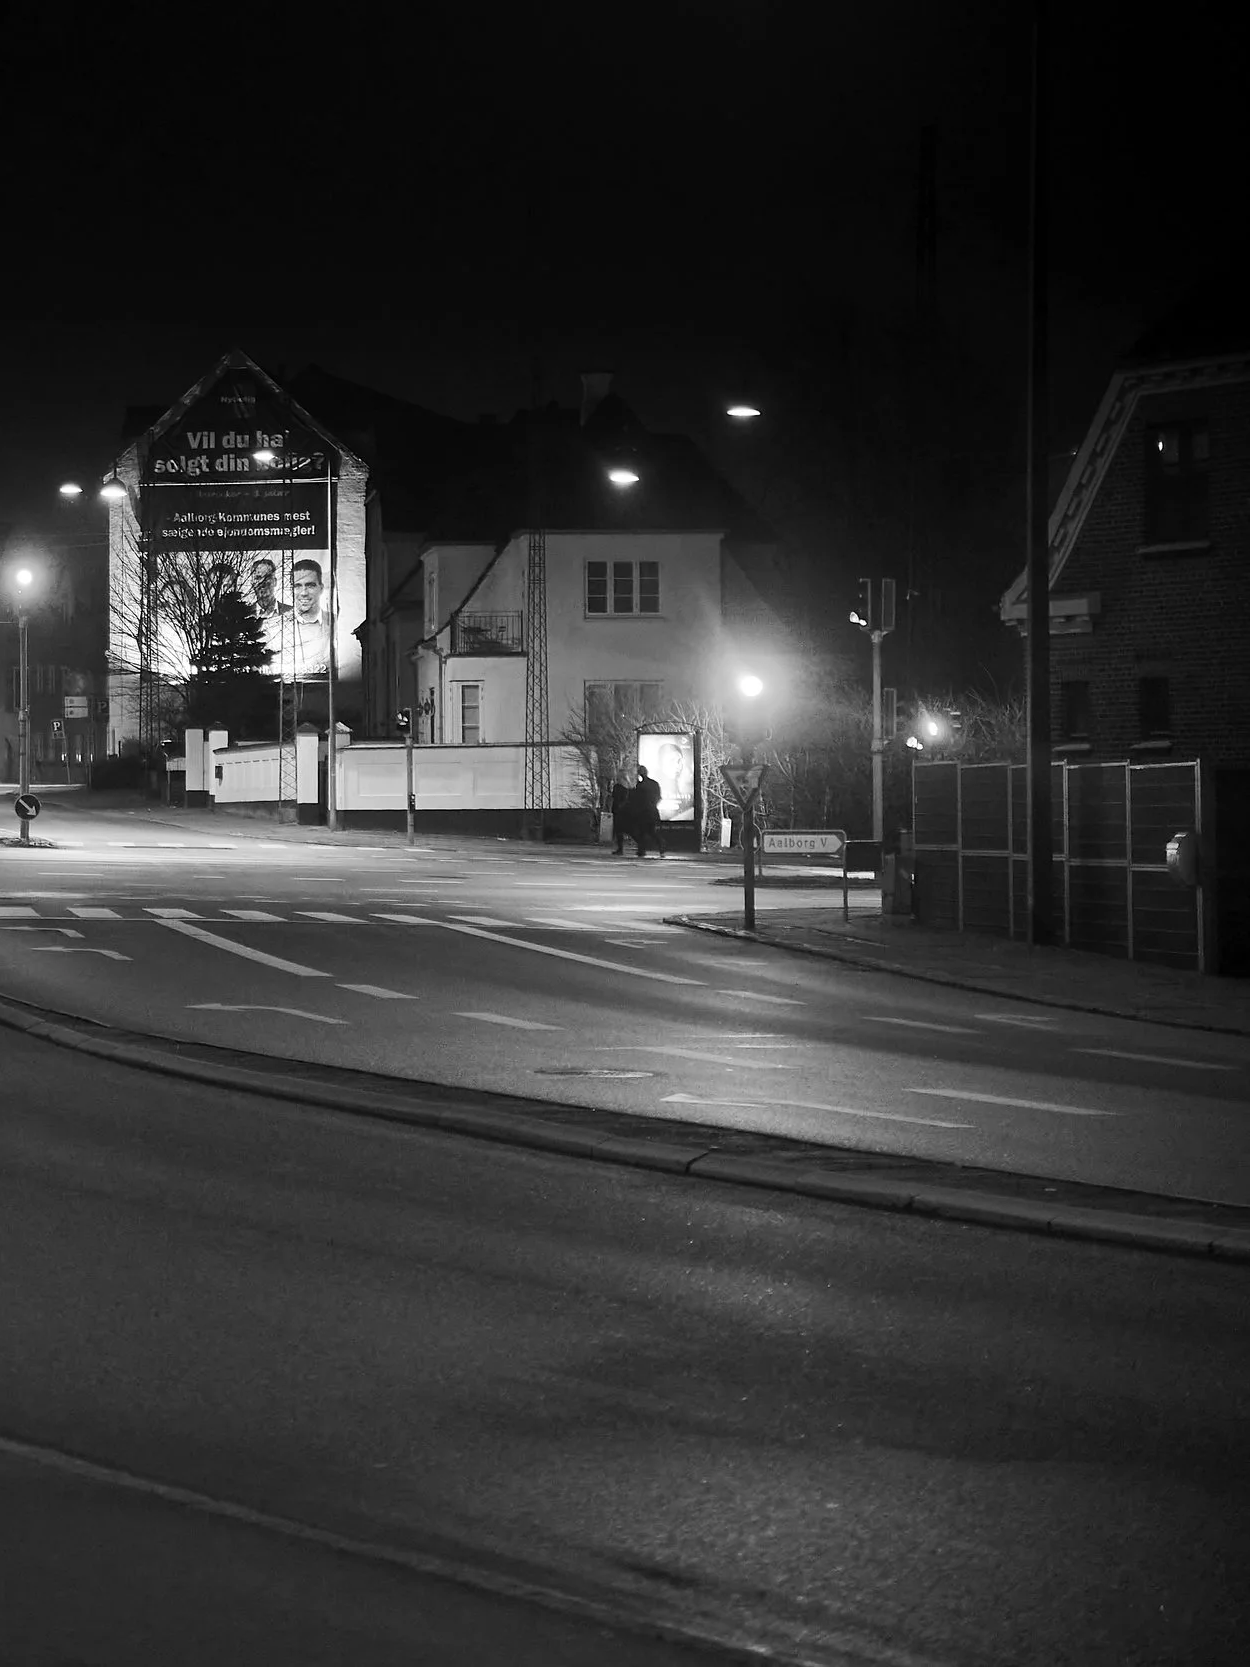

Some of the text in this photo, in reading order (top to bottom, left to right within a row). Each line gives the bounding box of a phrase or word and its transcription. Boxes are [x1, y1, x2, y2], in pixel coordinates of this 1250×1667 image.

[187, 431, 216, 449] Vil
[222, 431, 250, 449] du
[154, 455, 210, 477] solgt
[215, 454, 250, 472] din
[284, 510, 311, 522] mest
[768, 838, 827, 850] Aalborg V
